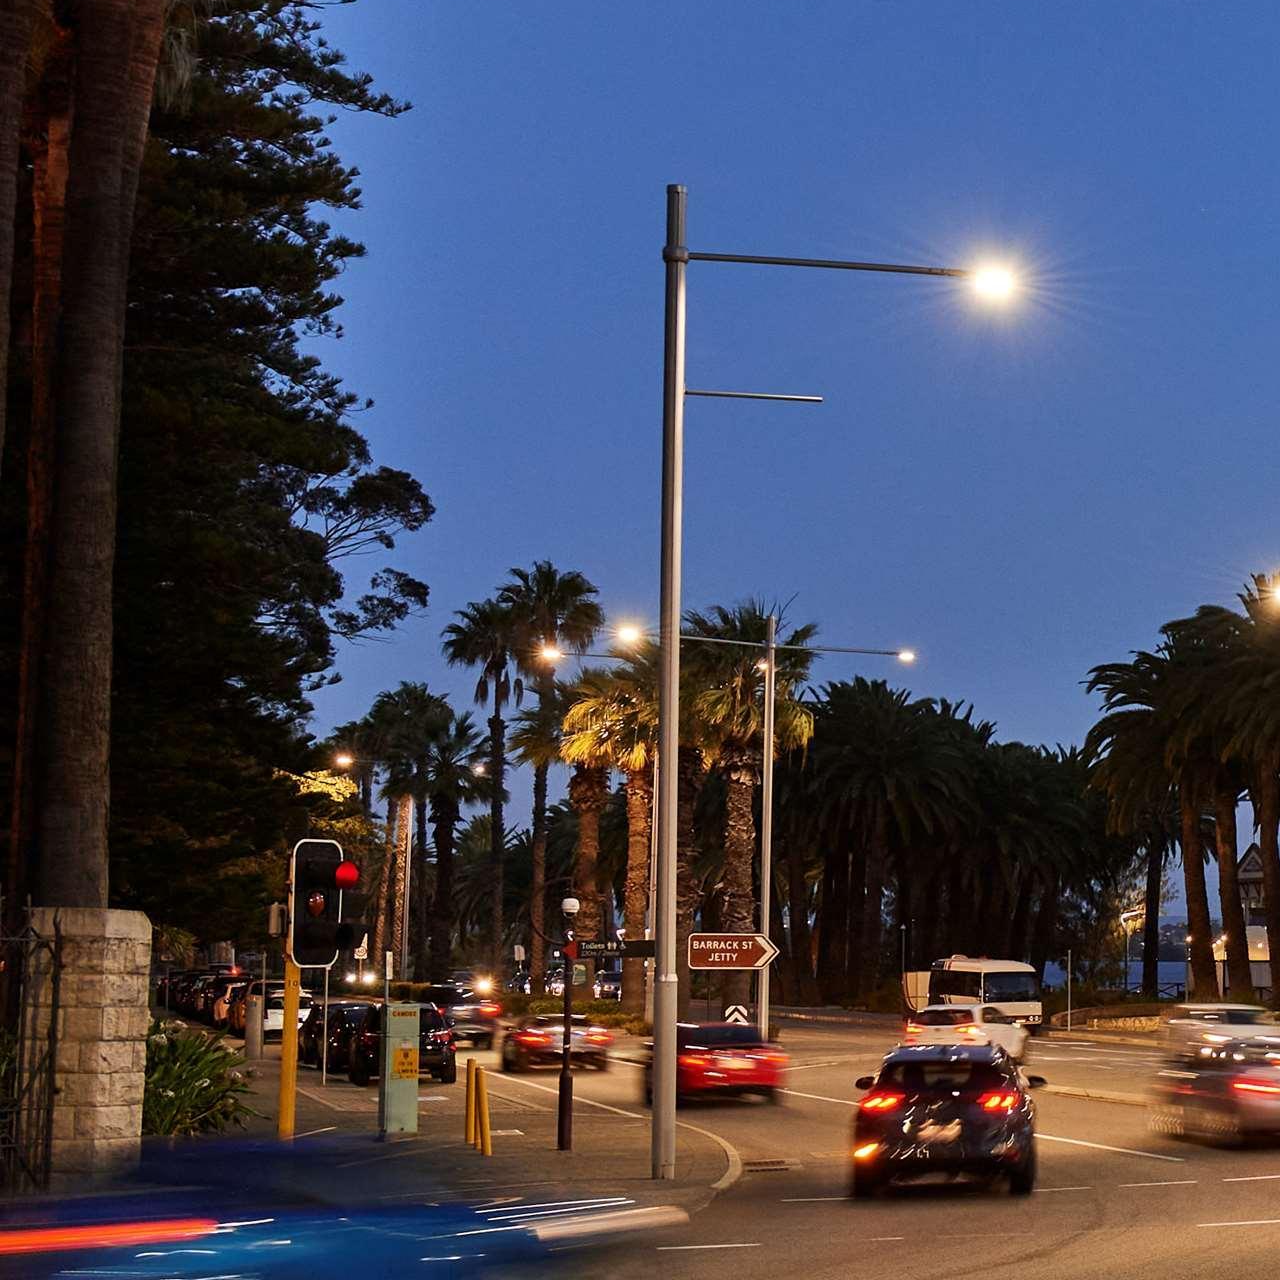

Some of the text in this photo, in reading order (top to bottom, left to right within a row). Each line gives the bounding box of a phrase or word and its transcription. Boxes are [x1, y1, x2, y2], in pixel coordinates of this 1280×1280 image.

[581, 941, 606, 950] Toilets
[692, 940, 753, 950] BARRACK ST
[708, 952, 738, 962] JETTY
